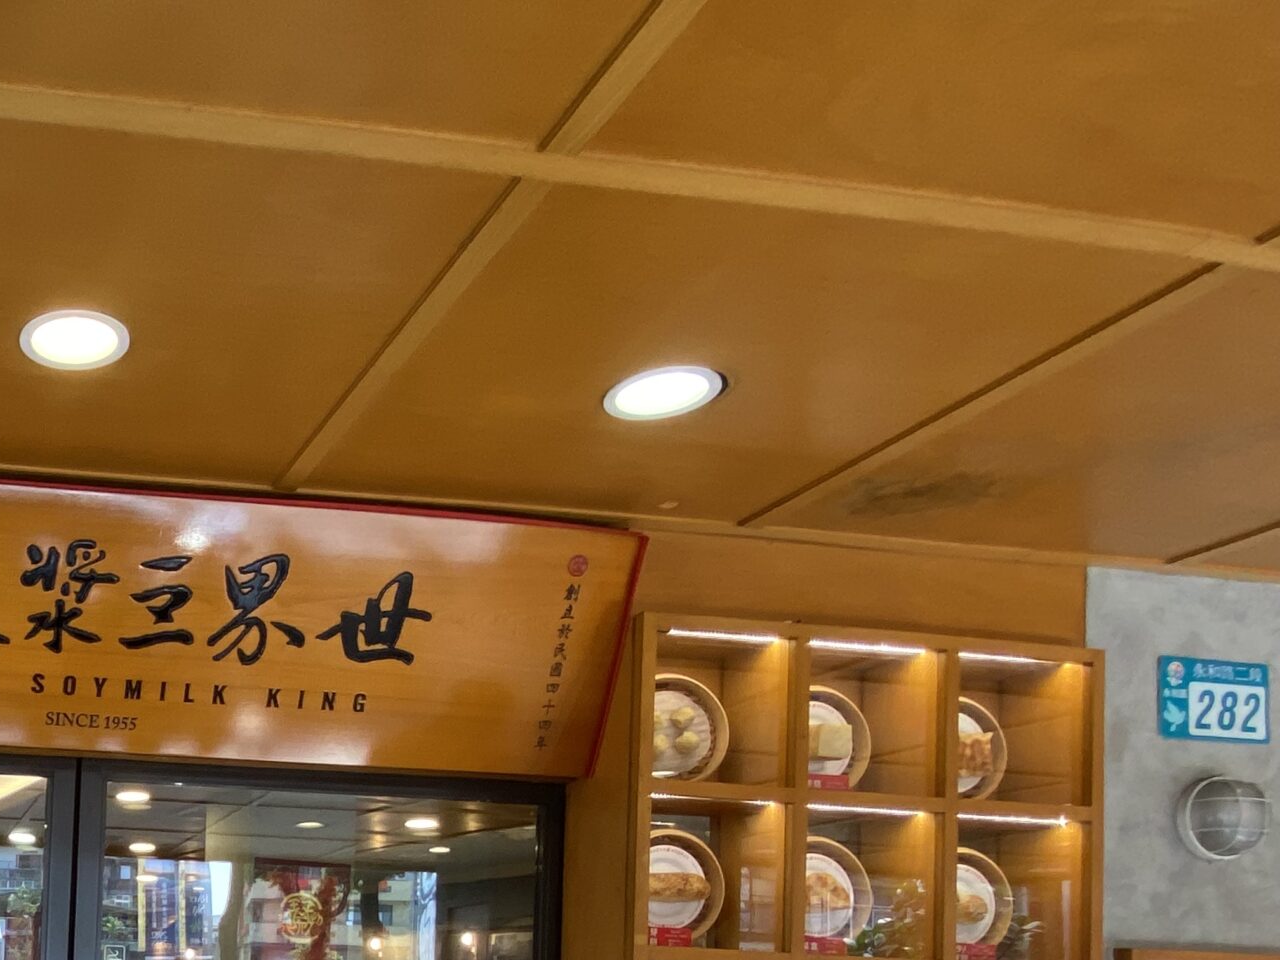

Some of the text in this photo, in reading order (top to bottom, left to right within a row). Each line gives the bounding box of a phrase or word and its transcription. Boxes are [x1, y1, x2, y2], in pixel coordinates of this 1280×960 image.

[31, 673, 227, 705] SOYMILK
[266, 688, 367, 712] KING
[1195, 689, 1260, 733] 282
[45, 711, 138, 730] SINCE 1955
